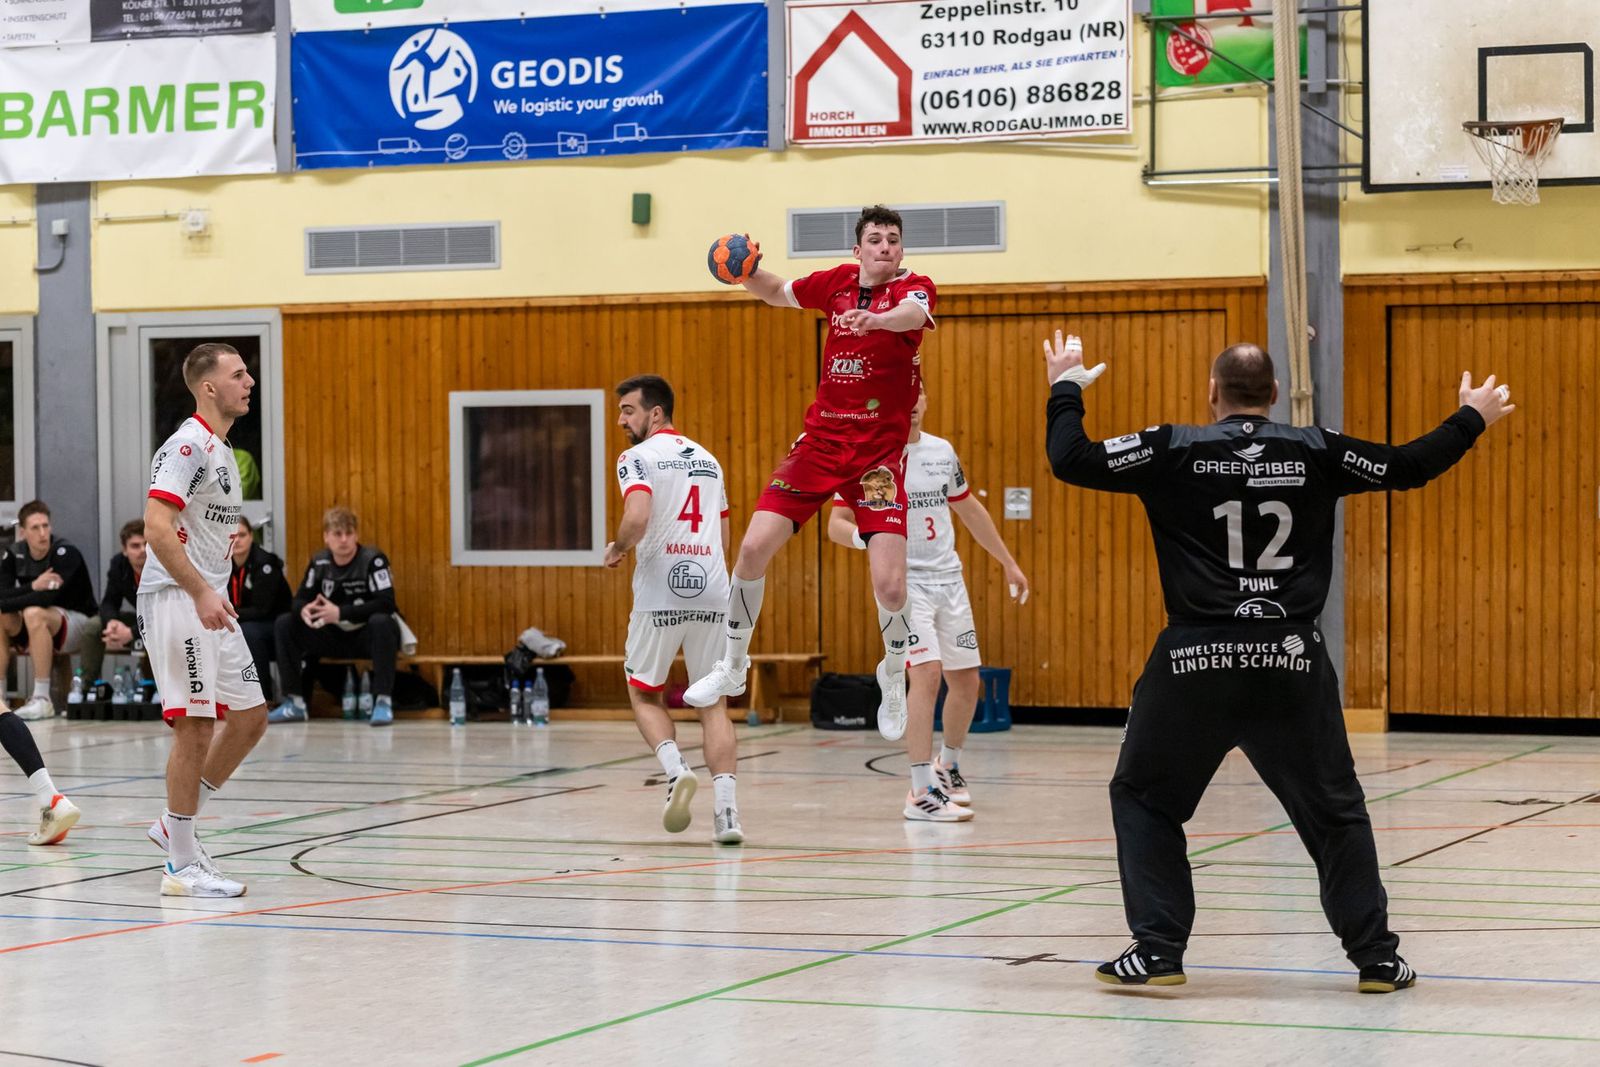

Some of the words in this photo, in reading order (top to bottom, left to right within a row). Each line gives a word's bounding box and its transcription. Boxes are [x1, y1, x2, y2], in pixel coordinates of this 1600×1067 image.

[920, 0, 1046, 21] Zeppelinstr.
[1055, 0, 1078, 10] 10
[921, 30, 984, 48] 63110
[993, 28, 1072, 46] Rodgau
[1080, 21, 1125, 42] (NR)
[491, 55, 624, 89] GEODIS
[923, 67, 971, 81] EINFACH
[973, 64, 1008, 74] MEHR,
[1011, 61, 1033, 71] ALS
[1035, 58, 1054, 68] SIE
[1056, 50, 1118, 65] ERWARTEN
[0, 80, 265, 139] BARMER
[494, 99, 518, 114] We
[521, 97, 574, 116] logistic
[576, 97, 611, 115] your
[612, 90, 665, 112] growth
[921, 86, 1017, 115] (06106)
[1027, 80, 1122, 104] 886828
[810, 111, 855, 121] HORCH
[923, 112, 1124, 135] WWW.RODGAU-IMMO.DE
[808, 125, 888, 138] IMMOBILIEN
[831, 358, 864, 375] KDE
[1193, 460, 1306, 476] GREENFIBER
[1343, 450, 1388, 476] pmd
[678, 485, 703, 534] 4
[925, 517, 937, 541] 3
[1213, 500, 1294, 570] 12
[666, 543, 712, 556] KARAULA
[672, 565, 704, 590] ifm
[1239, 577, 1279, 592] PUHL
[185, 638, 198, 679] KRÖNA
[1170, 642, 1278, 660] UMWELTSERVICE
